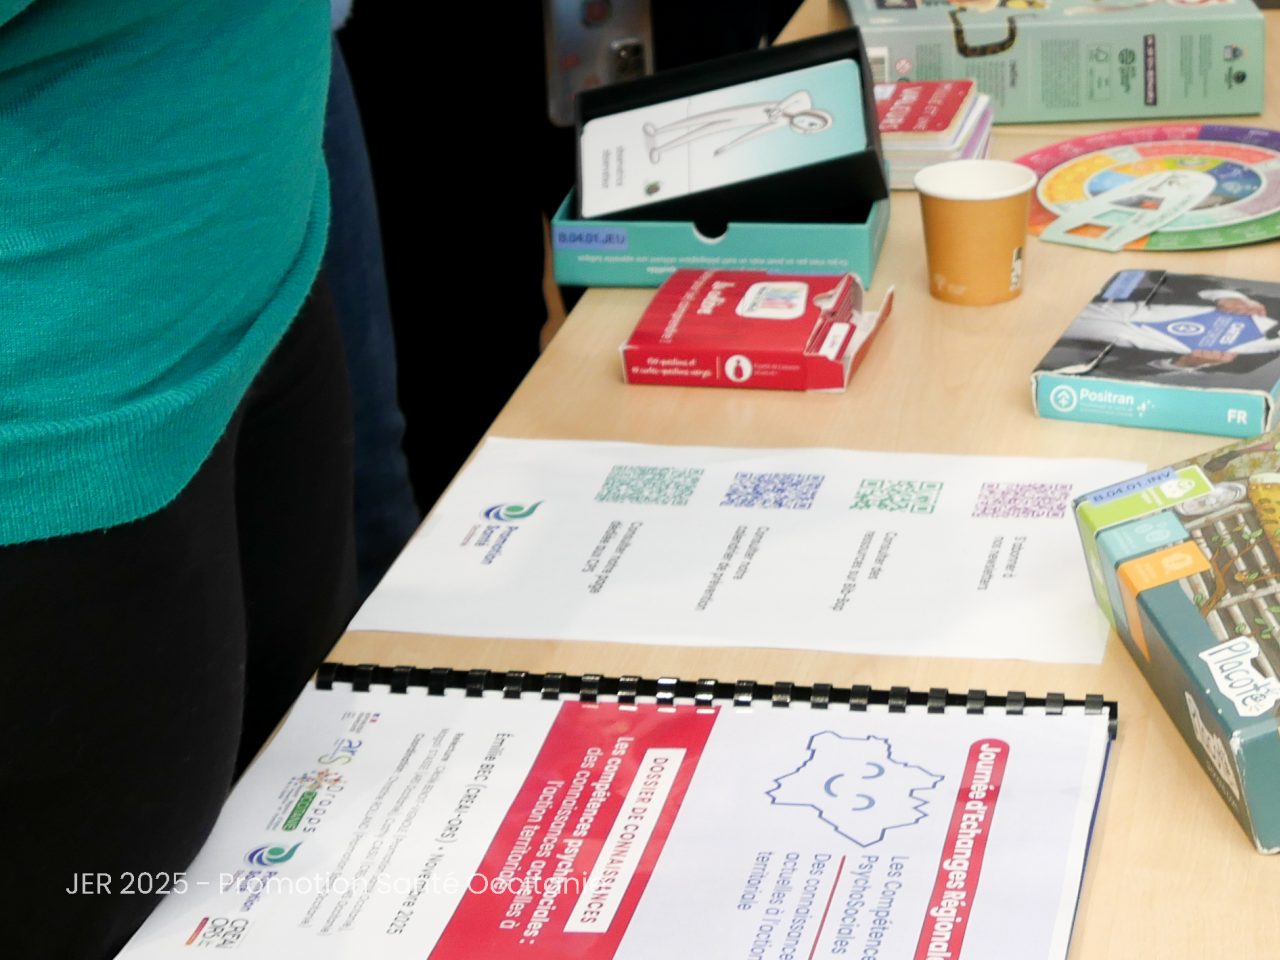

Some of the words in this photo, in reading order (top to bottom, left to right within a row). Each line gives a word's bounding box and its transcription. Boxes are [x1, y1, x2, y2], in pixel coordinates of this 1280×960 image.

[1079, 389, 1134, 405] Positran
[1227, 409, 1248, 424] FR
[1208, 641, 1272, 708] Placote
[581, 747, 604, 769] des
[613, 736, 635, 756] Les
[474, 763, 496, 782] BEC
[638, 757, 669, 803] DOSSIER
[968, 743, 1002, 800] Journée
[528, 780, 565, 823] l'action
[536, 770, 590, 857] connaissances
[573, 757, 621, 837] compétences
[628, 806, 648, 820] DE
[494, 825, 540, 891] territoriale
[809, 853, 832, 876] Des
[886, 855, 909, 879] Les
[942, 801, 988, 889] d'Echanges
[402, 854, 444, 907] Novembre
[580, 823, 639, 924] CONNAISSANCES
[737, 851, 775, 911] territoriale
[769, 852, 800, 905] actuelles
[386, 910, 414, 935] 2025
[500, 919, 520, 929] à
[765, 906, 785, 916] à
[831, 854, 879, 954] PsychoSociales
